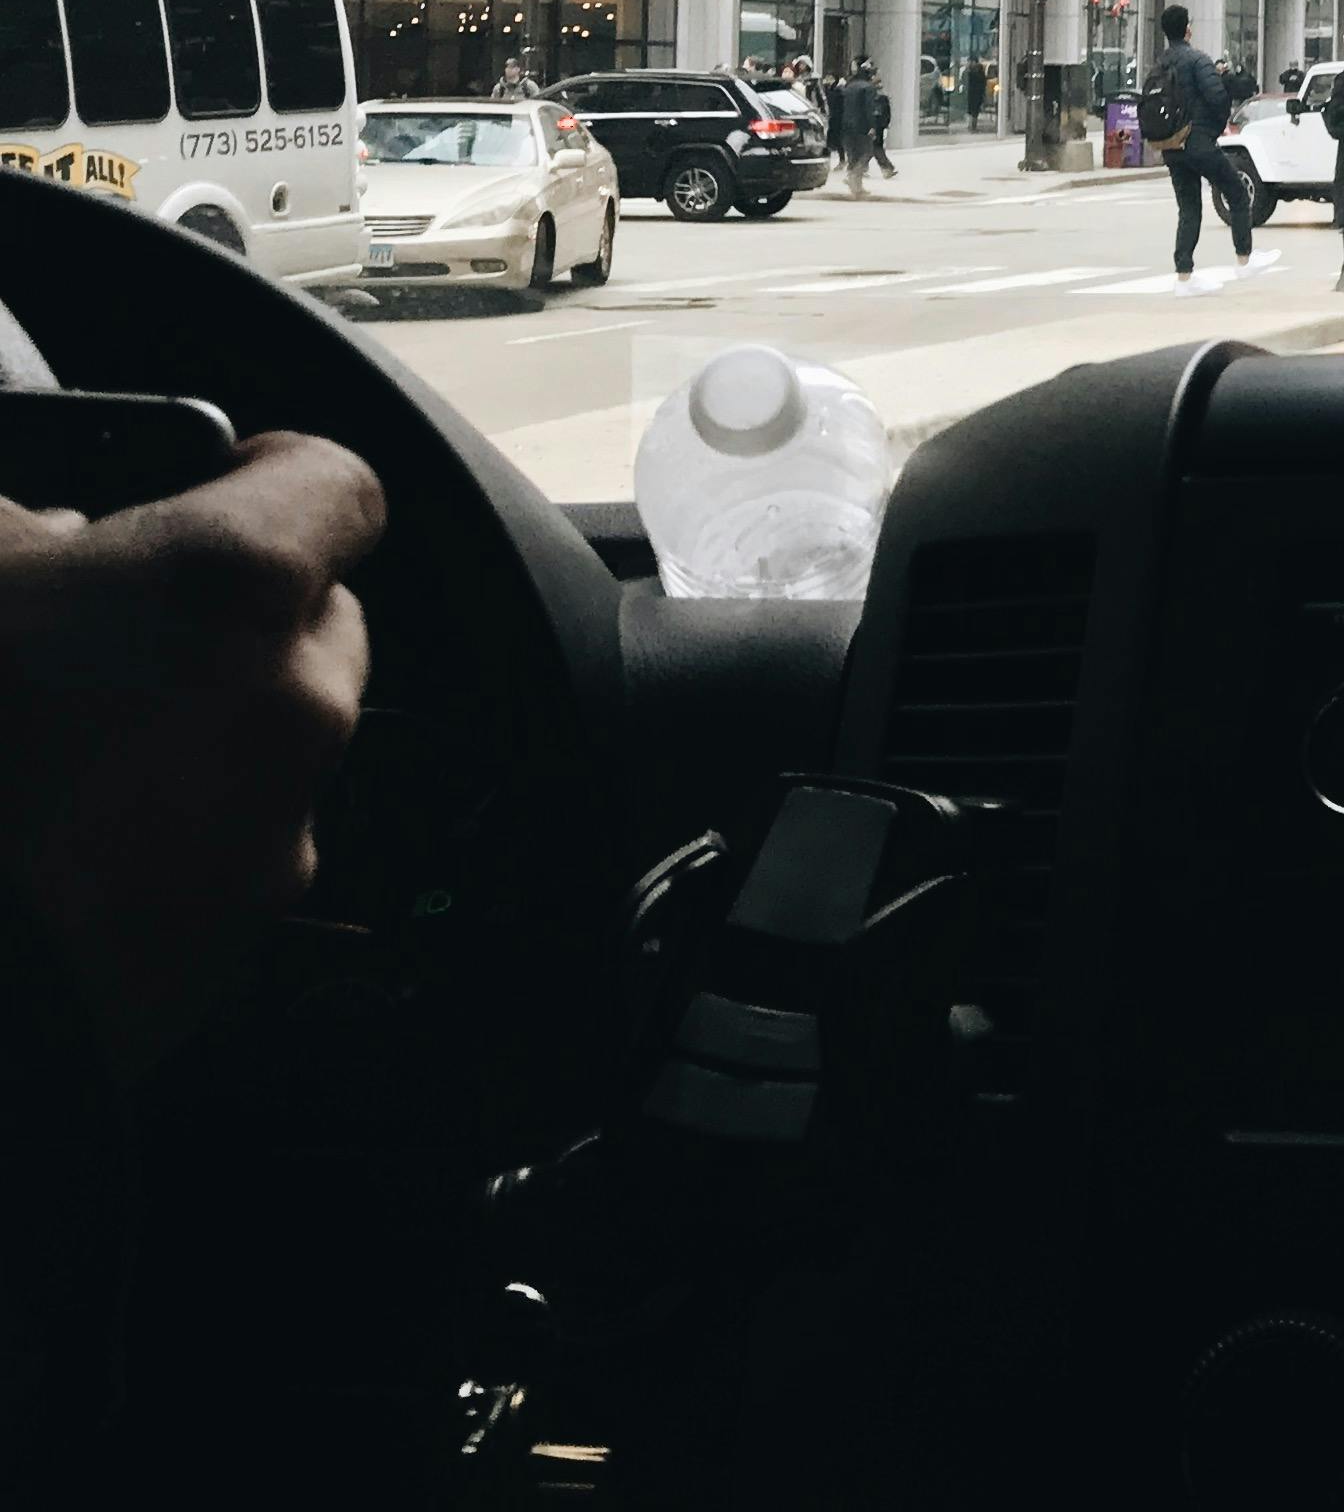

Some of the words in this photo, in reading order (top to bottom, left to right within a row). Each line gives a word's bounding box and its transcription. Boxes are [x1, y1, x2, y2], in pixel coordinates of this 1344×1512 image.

[180, 129, 238, 160] (773)
[244, 123, 344, 153] 525-6152
[86, 155, 125, 188] ALL!
